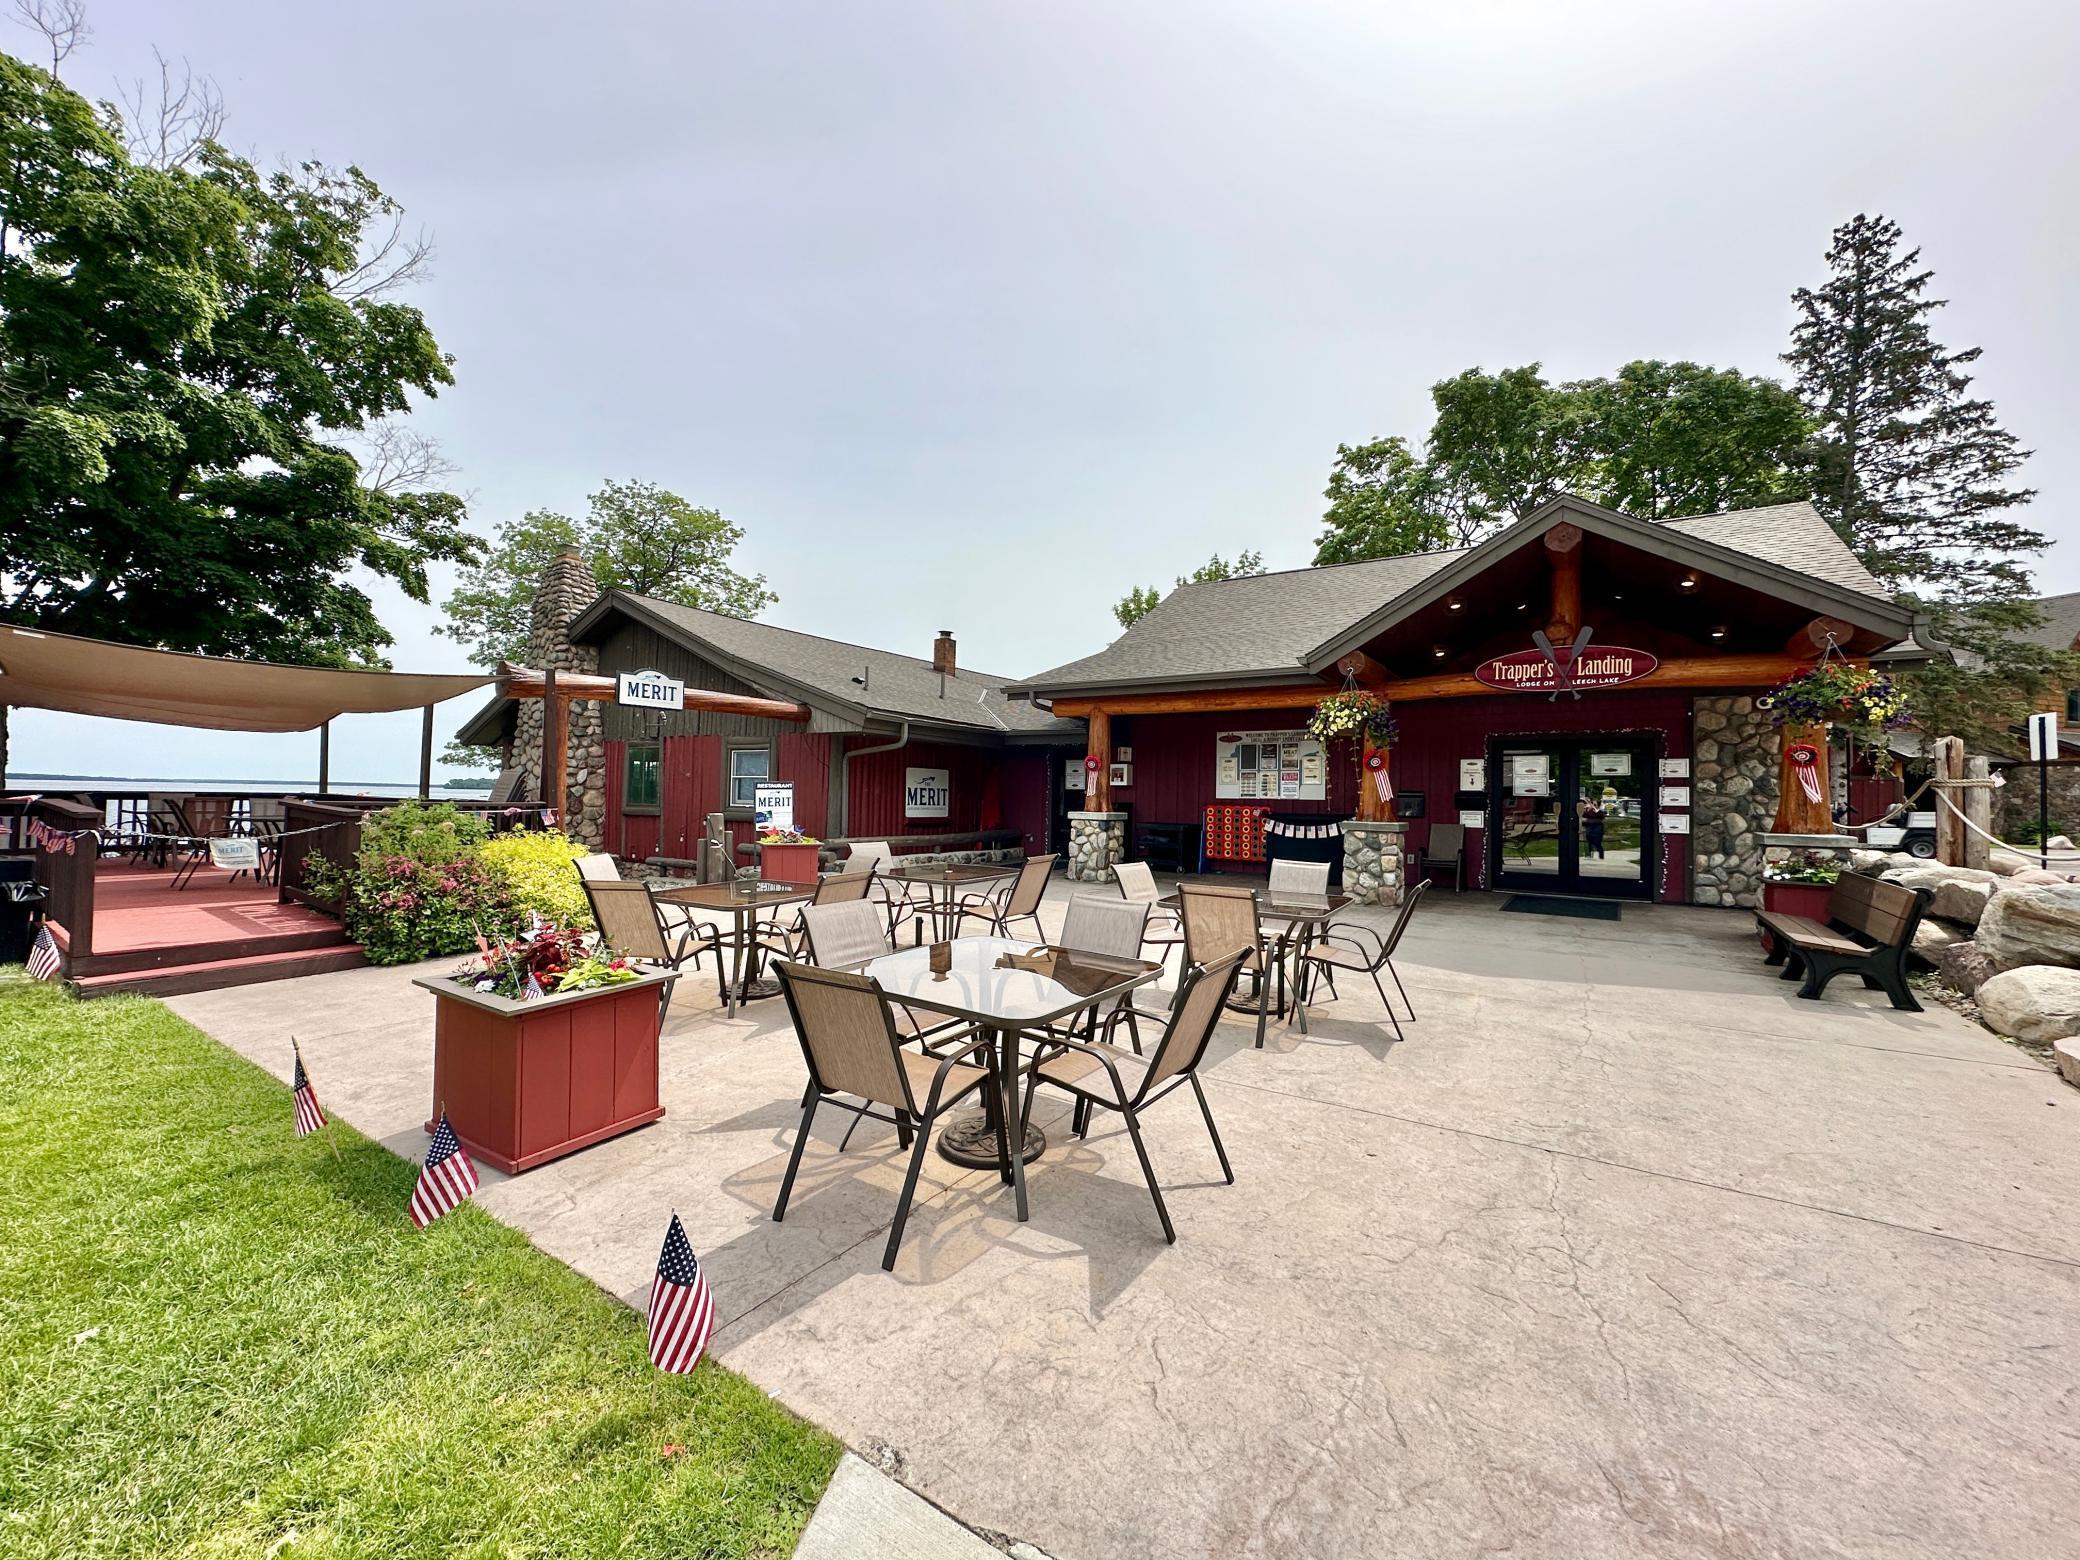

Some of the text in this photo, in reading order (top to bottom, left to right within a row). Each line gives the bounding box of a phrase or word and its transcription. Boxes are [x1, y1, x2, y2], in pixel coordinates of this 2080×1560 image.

[1492, 655, 1632, 681] Trapper's Landing
[627, 682, 677, 701] MERIT
[758, 797, 791, 807] MERIT
[907, 787, 948, 806] MERIT
[218, 846, 243, 854] MERIT
